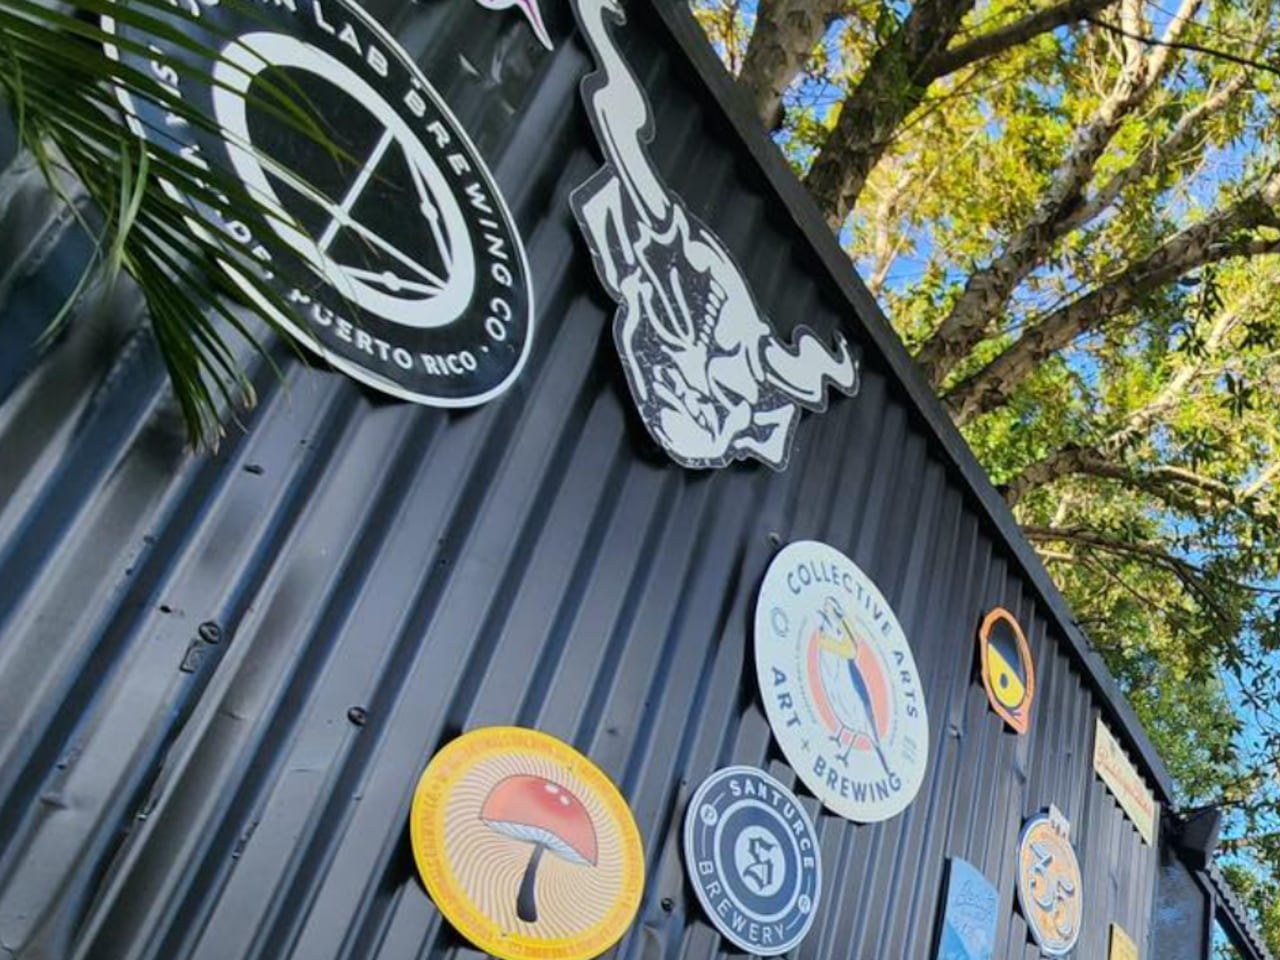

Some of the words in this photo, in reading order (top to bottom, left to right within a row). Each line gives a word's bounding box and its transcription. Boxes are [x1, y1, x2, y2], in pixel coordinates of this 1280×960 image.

[403, 88, 513, 287] BREWING
[421, 351, 478, 376] RICO
[787, 560, 893, 637] COLLECTIVE
[893, 650, 919, 719] ARTS
[771, 666, 803, 728] ART
[813, 755, 901, 803] BREWING
[729, 779, 815, 869] SANTURCE
[699, 860, 785, 944] BREWERY
